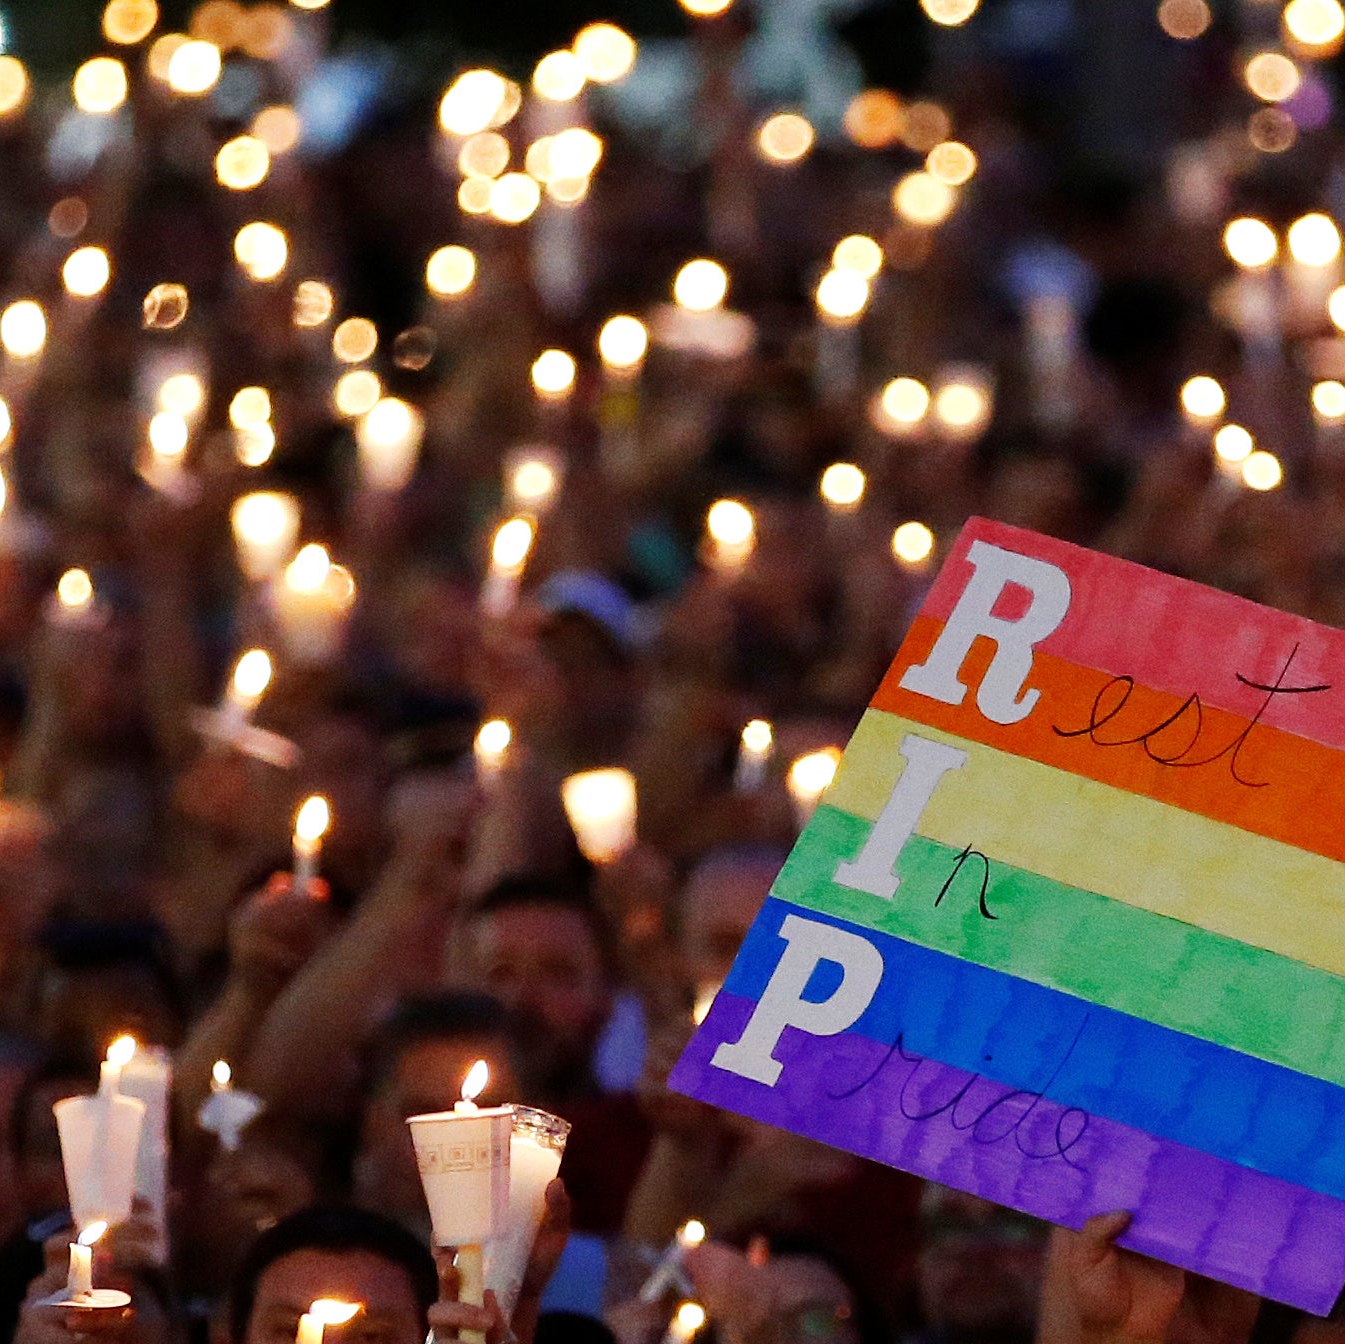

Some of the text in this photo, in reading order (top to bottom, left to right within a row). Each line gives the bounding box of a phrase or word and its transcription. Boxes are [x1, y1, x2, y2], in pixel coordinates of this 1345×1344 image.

[900, 540, 1330, 787] Rest
[835, 733, 997, 920] In
[711, 913, 1091, 1170] Pride
